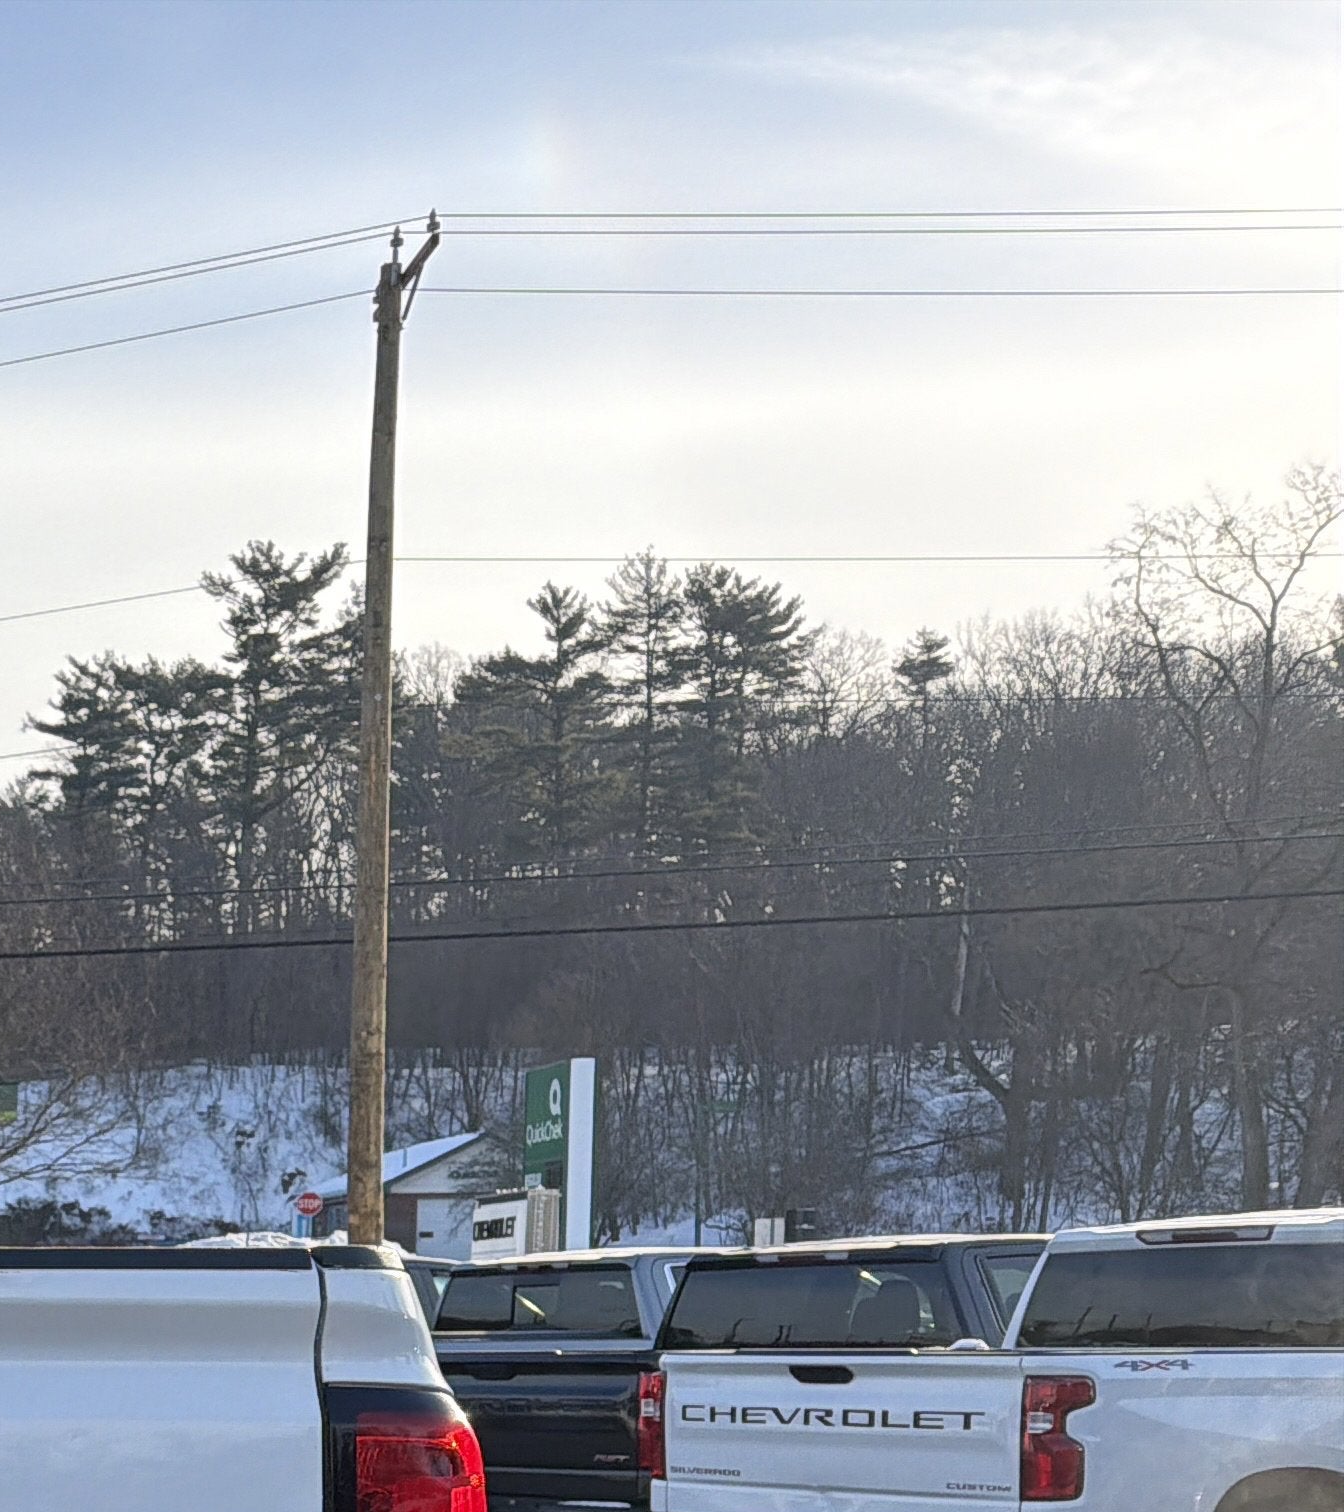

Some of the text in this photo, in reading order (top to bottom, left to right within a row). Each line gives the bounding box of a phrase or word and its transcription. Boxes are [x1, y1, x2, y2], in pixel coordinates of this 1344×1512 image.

[526, 1117, 563, 1147] QuickChek
[298, 1199, 321, 1209] STOP
[681, 1404, 986, 1430] CHEVROLET
[670, 1465, 741, 1477] SILVERADO
[946, 1482, 1012, 1492] CUSTOM
